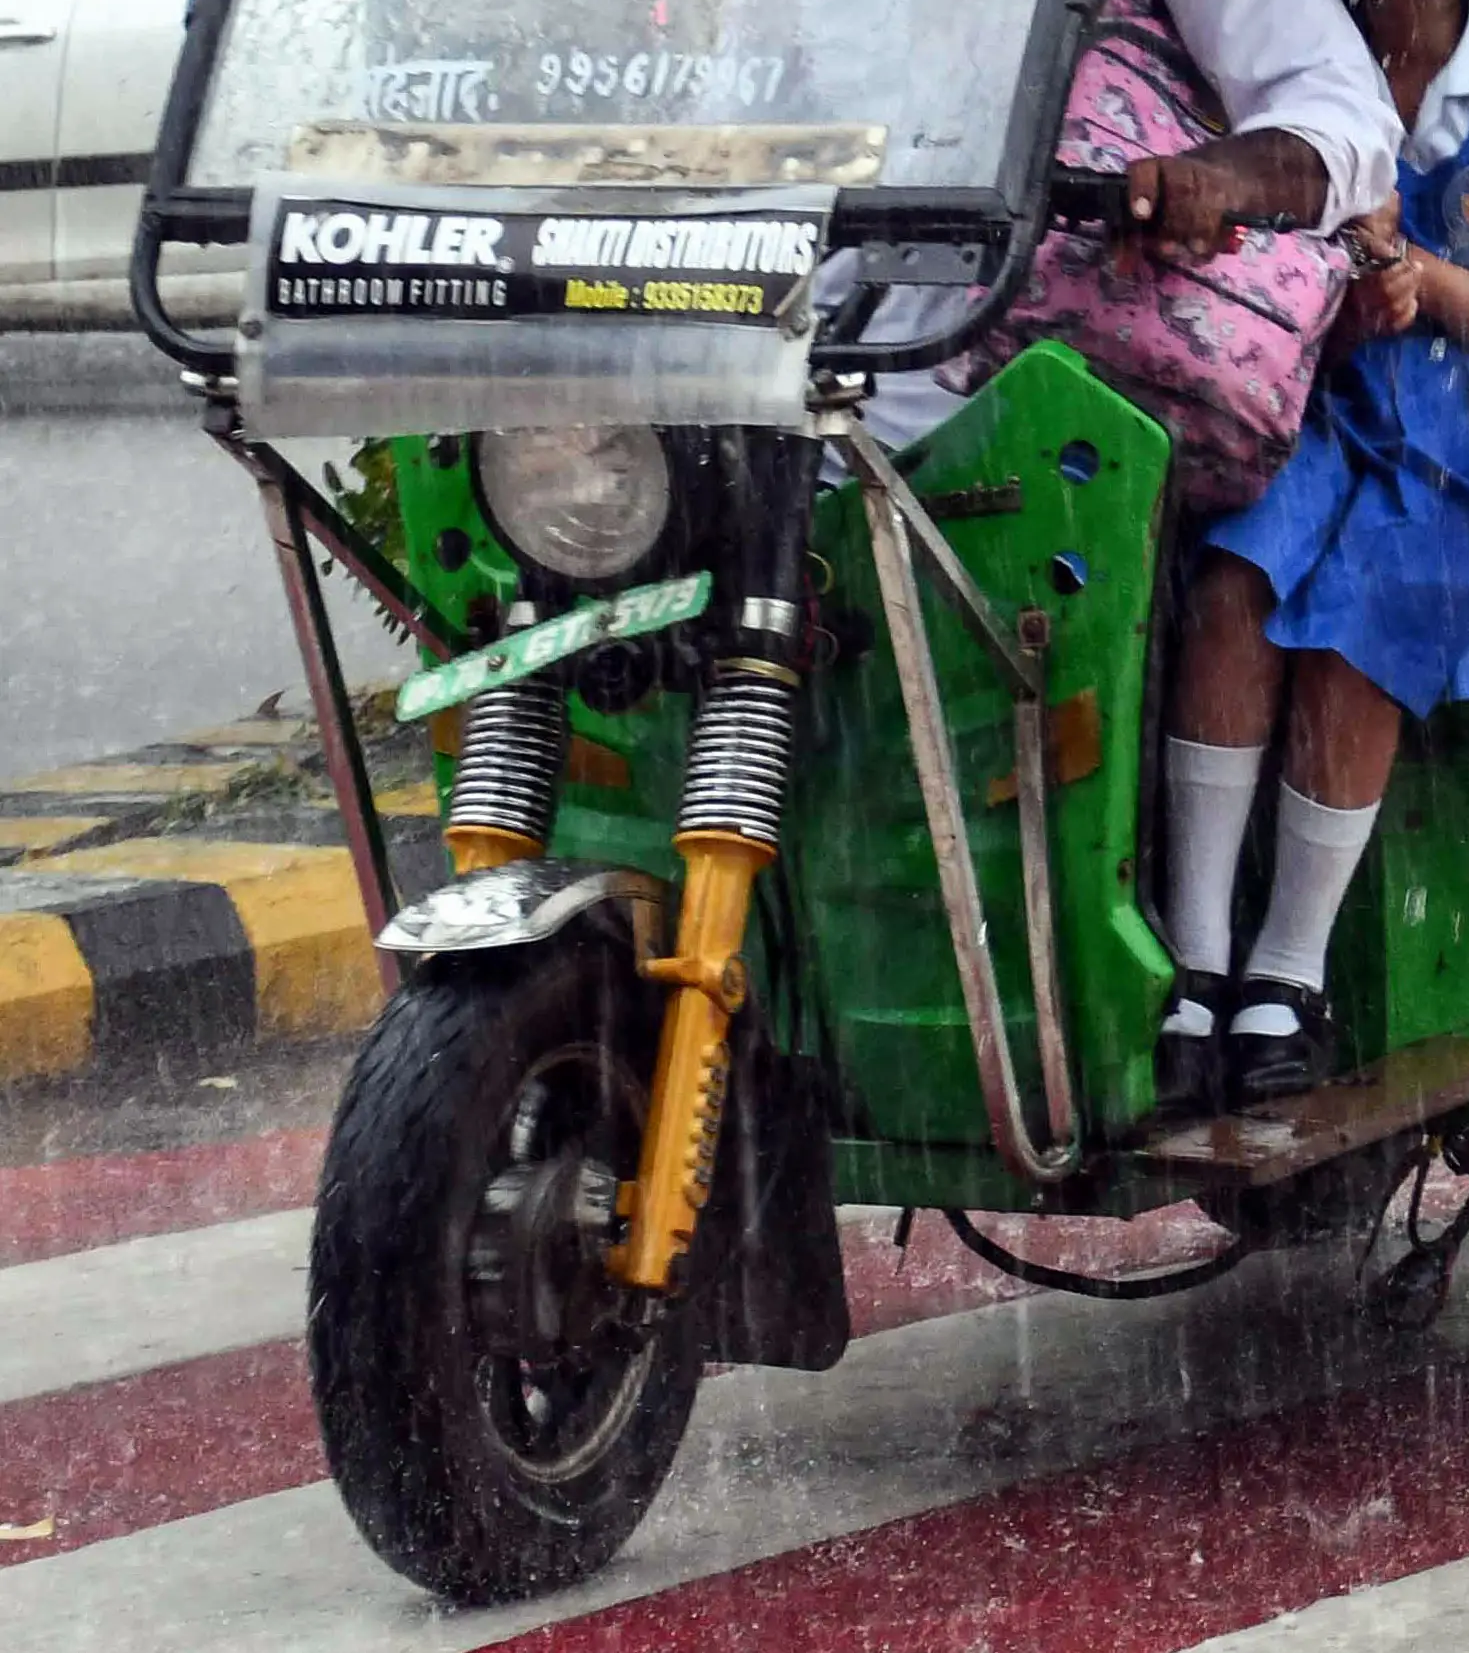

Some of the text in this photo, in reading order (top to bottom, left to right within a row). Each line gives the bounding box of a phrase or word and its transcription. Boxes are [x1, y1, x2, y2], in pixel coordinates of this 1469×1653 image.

[280, 212, 504, 265] KOHLER
[278, 278, 507, 307] BATHROOM FITTING
